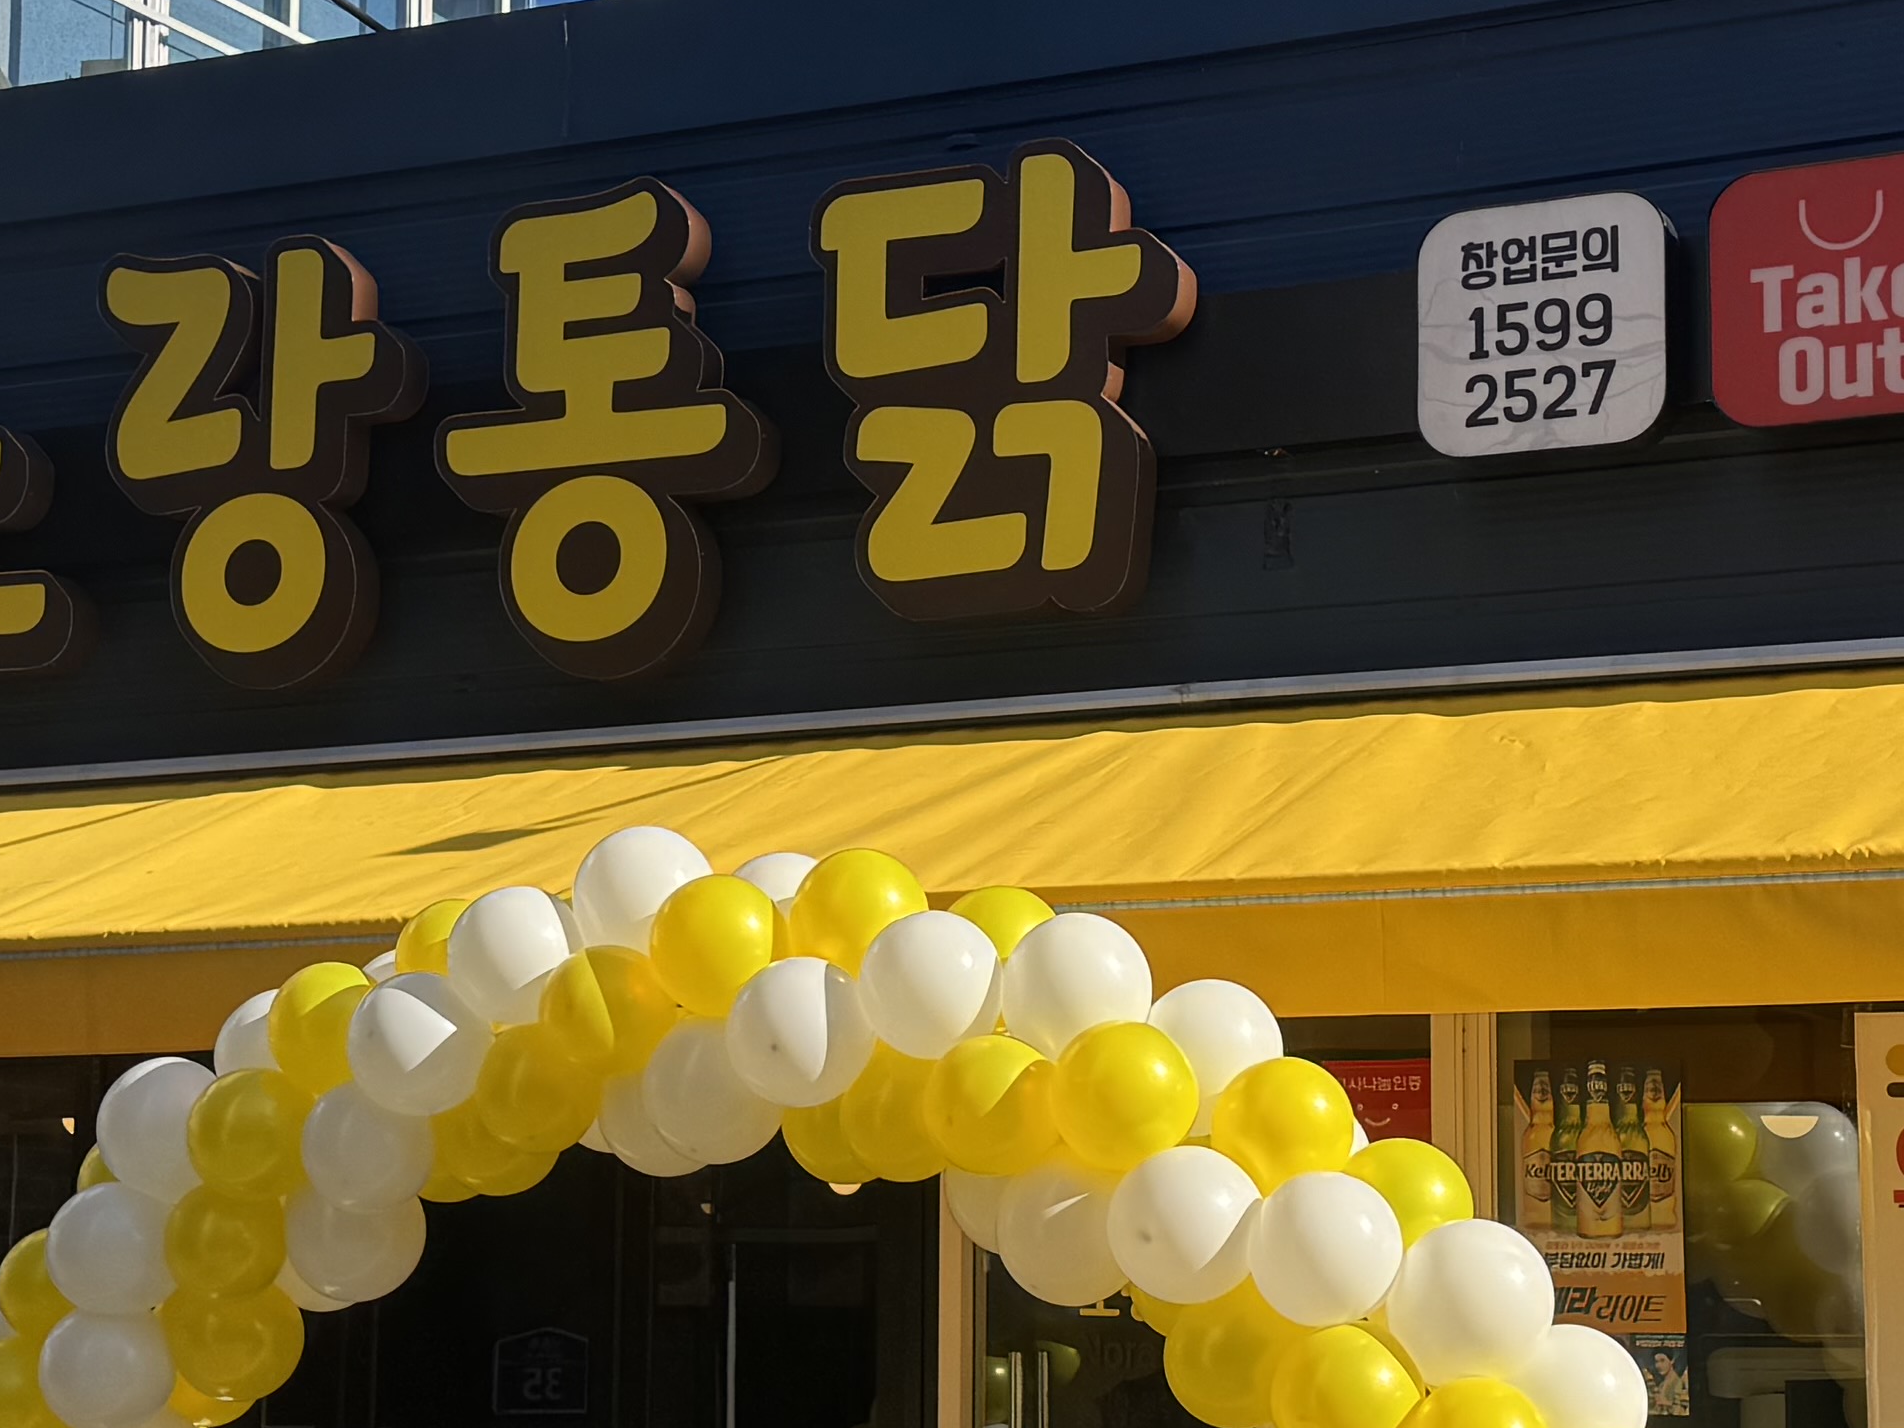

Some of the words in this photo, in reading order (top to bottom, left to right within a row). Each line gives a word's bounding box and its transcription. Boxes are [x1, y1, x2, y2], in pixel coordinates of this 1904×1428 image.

[1459, 222, 1622, 288] 창업문의
[1464, 294, 1615, 362] 1599
[1464, 360, 1618, 430] 2527
[1577, 1161, 1621, 1182] TERRA
[1597, 1294, 1667, 1323] 라이트
